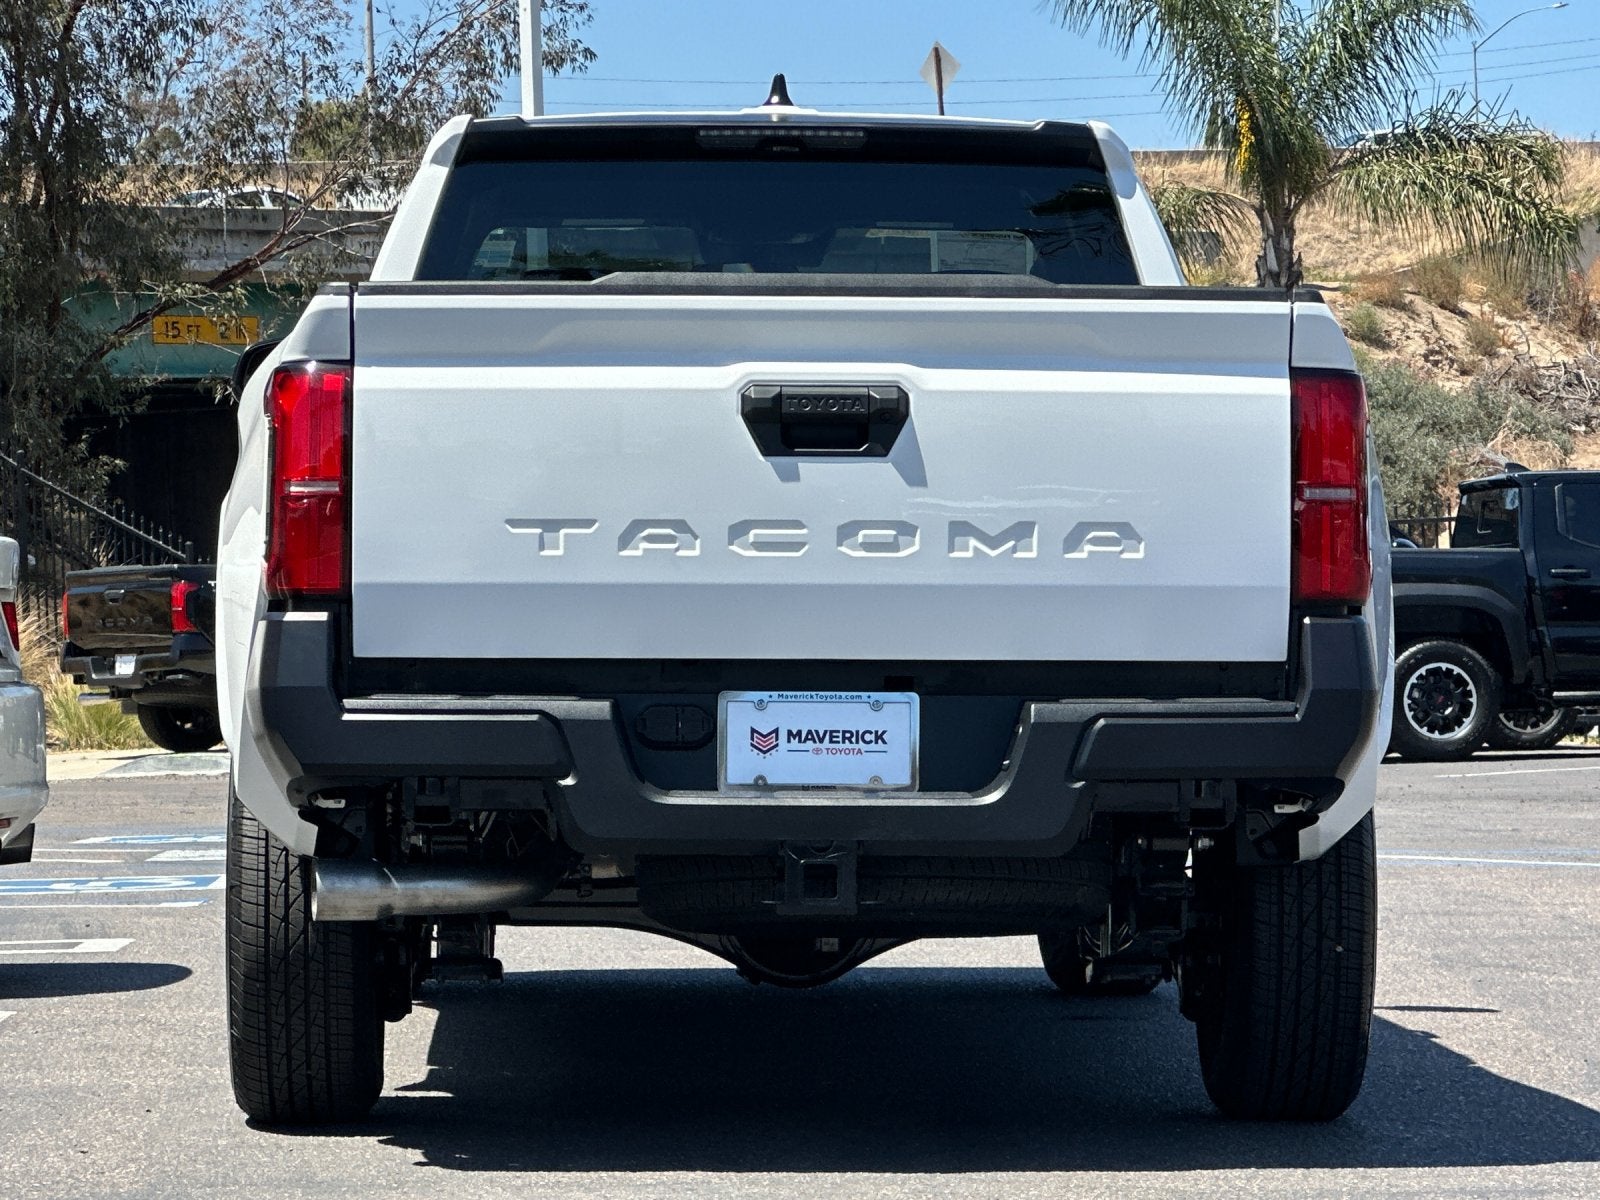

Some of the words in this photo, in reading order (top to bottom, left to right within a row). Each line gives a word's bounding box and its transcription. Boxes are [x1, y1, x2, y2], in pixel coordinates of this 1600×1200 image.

[164, 321, 181, 339] 15
[186, 324, 201, 339] FT
[219, 322, 229, 339] 2
[786, 398, 866, 412] TOYOTA
[504, 518, 1147, 560] TACOMA
[777, 693, 863, 701] MaverickToyota.com
[786, 729, 888, 745] MAVERICK
[825, 747, 863, 756] TOYOTA
